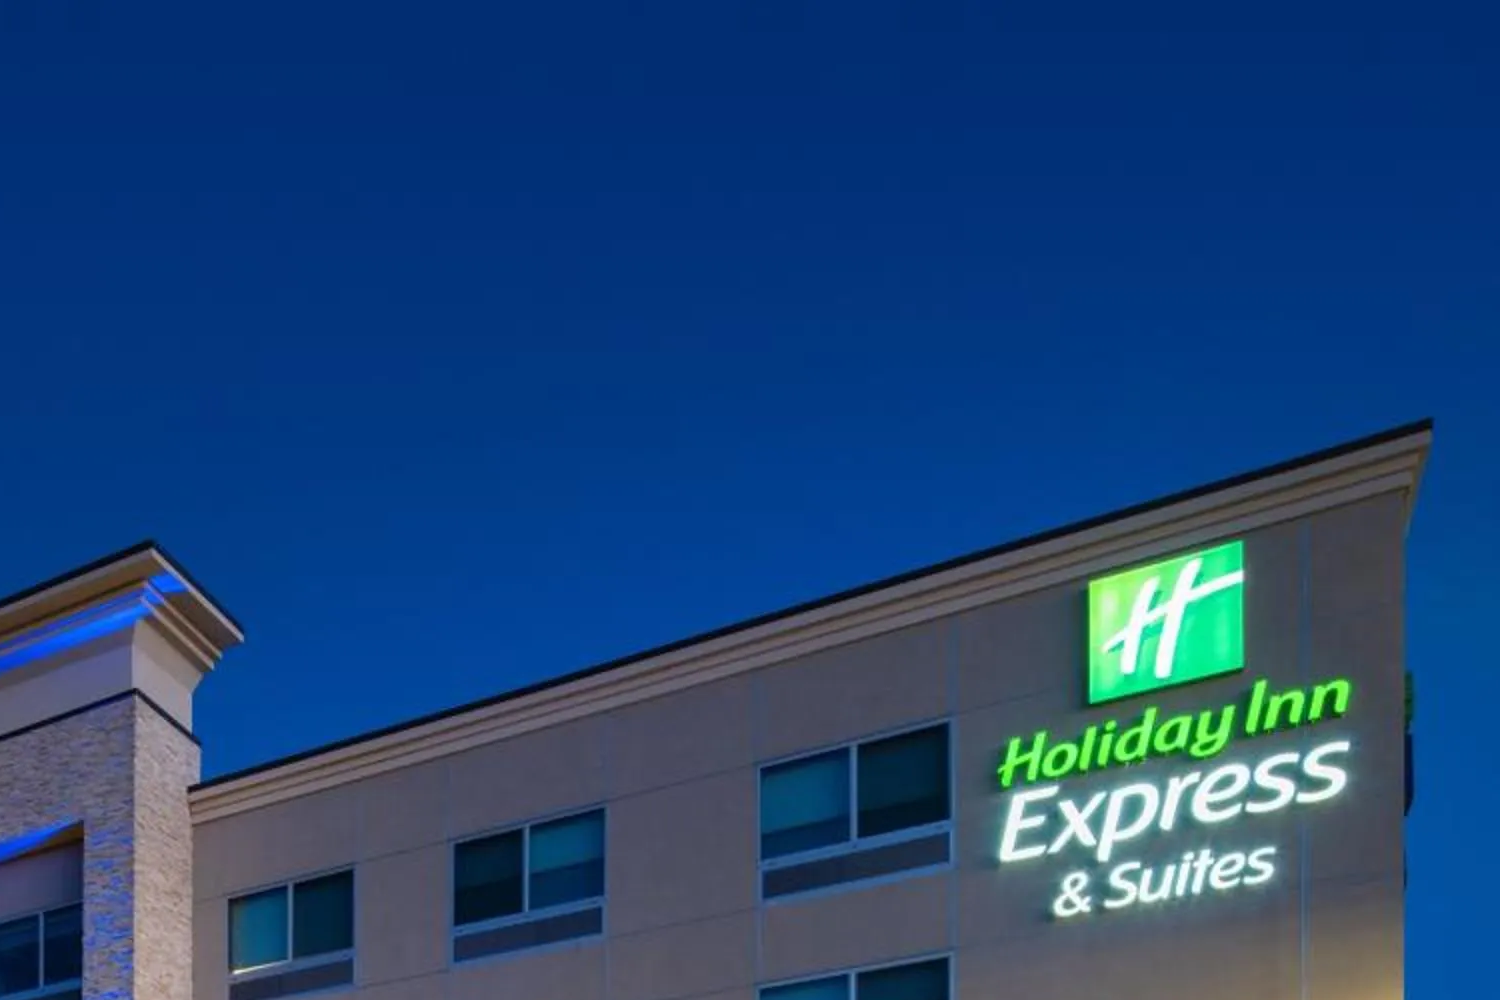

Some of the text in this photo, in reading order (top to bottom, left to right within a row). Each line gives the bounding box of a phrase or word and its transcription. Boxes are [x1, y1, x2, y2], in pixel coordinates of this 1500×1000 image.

[1102, 558, 1245, 678] H
[998, 679, 1351, 787] Holiday Inn
[1000, 741, 1351, 864] Express
[1052, 845, 1277, 918] & Suites
